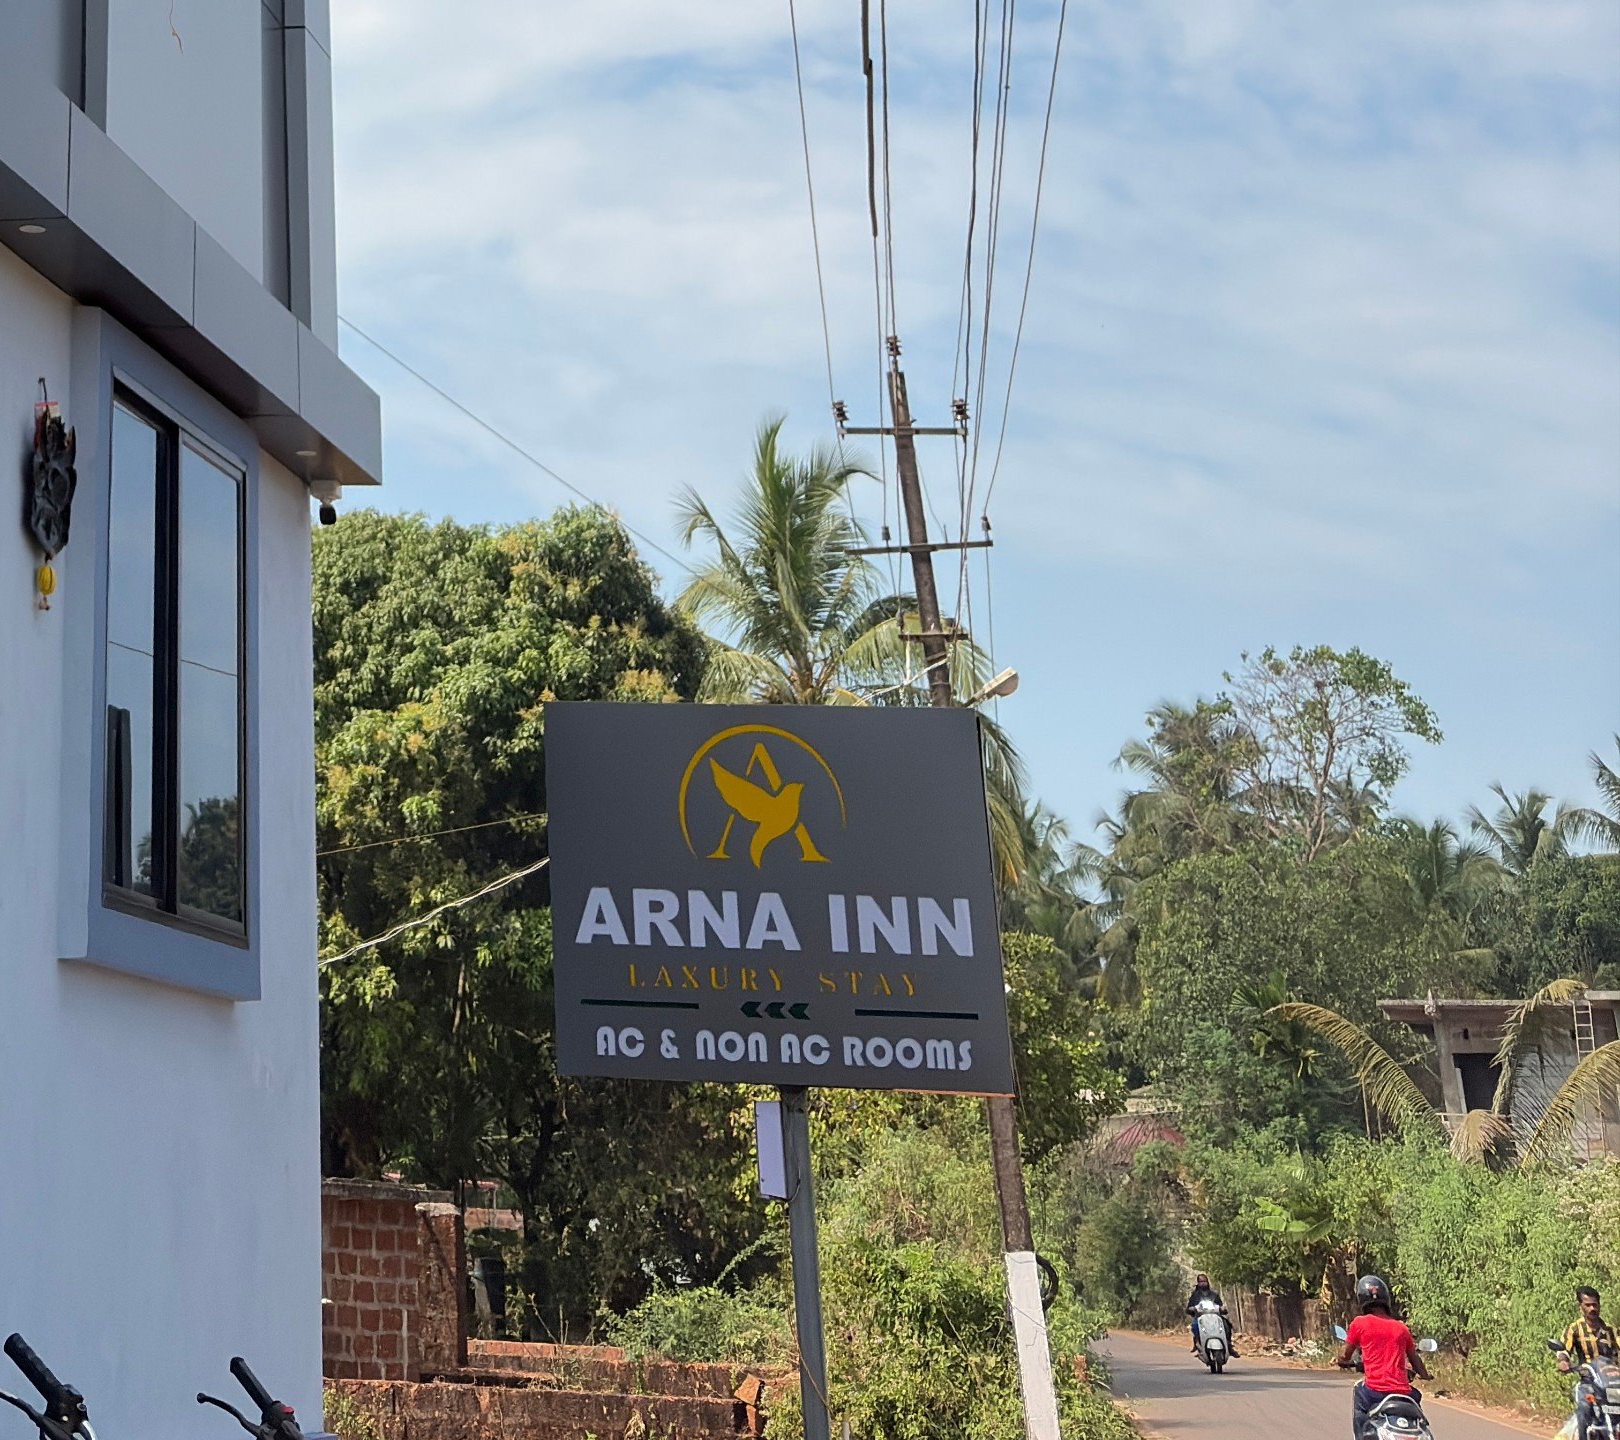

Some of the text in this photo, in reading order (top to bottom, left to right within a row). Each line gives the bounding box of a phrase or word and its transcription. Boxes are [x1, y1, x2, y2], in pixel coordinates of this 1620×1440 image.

[575, 886, 974, 957] ARNA INN
[628, 963, 919, 997] LAXURY STAY
[596, 1025, 645, 1058] AC
[660, 1028, 680, 1060] &
[780, 1033, 831, 1066] AC
[842, 1035, 972, 1072] ROOMS
